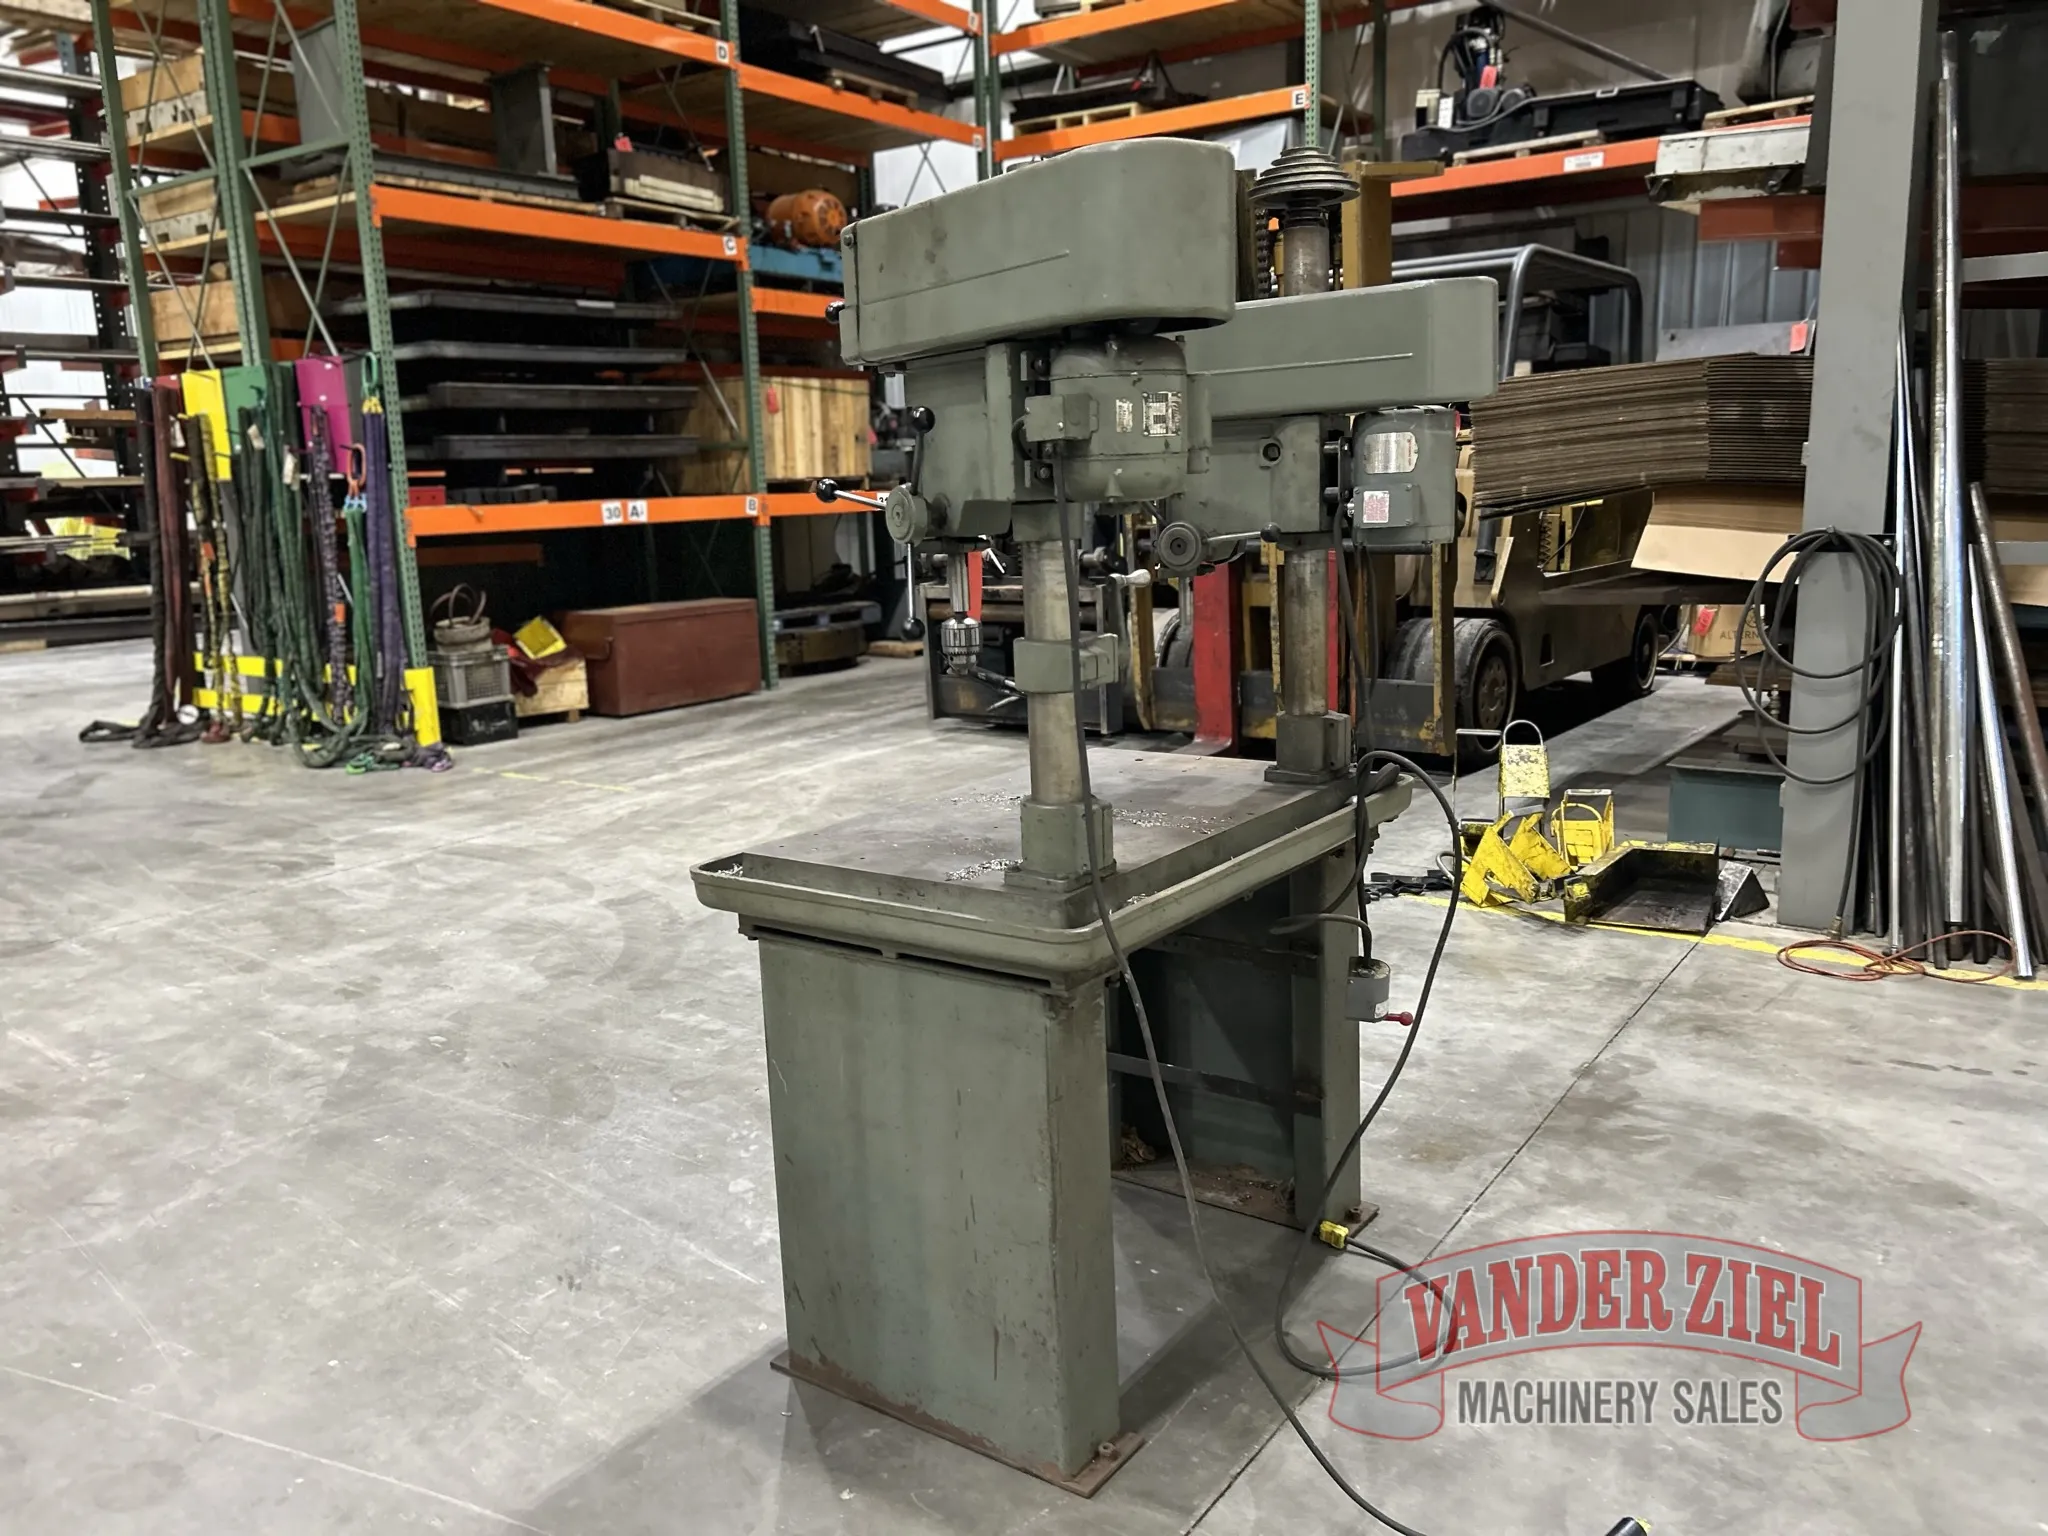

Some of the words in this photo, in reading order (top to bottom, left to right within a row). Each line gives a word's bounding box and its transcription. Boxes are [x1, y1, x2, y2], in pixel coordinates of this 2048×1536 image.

[1294, 92, 1304, 106] E
[748, 499, 757, 512] B
[605, 507, 621, 520] 30
